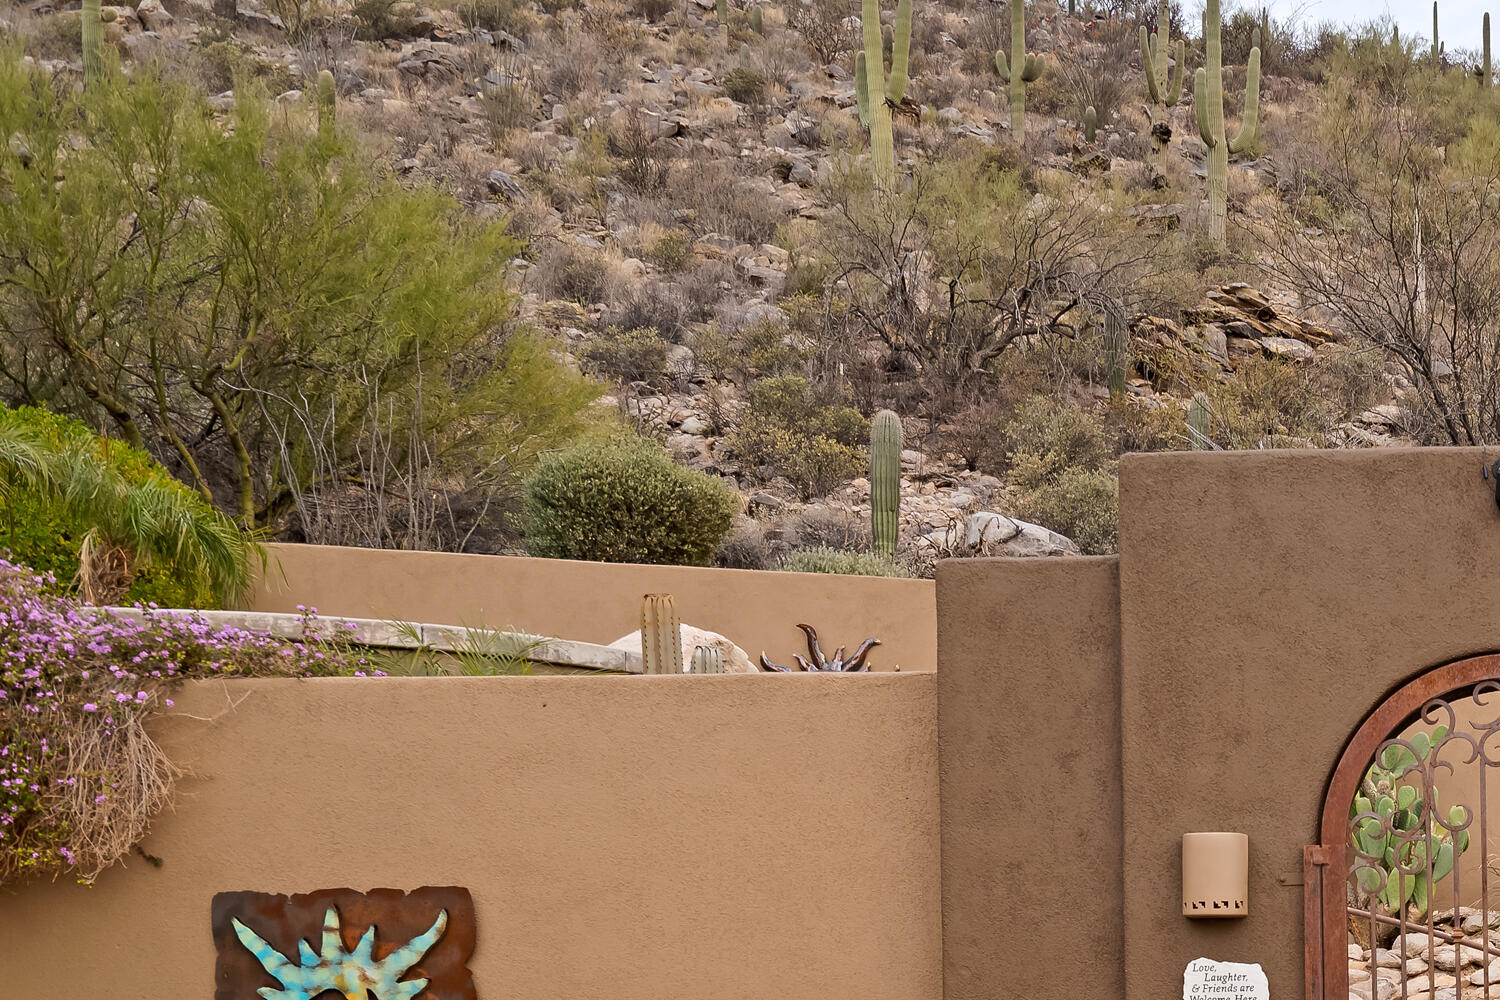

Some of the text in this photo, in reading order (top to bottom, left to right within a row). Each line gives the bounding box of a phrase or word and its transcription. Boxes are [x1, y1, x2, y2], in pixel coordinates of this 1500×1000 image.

[1192, 963, 1217, 973] Love,
[1191, 983, 1255, 993] & Friends are
